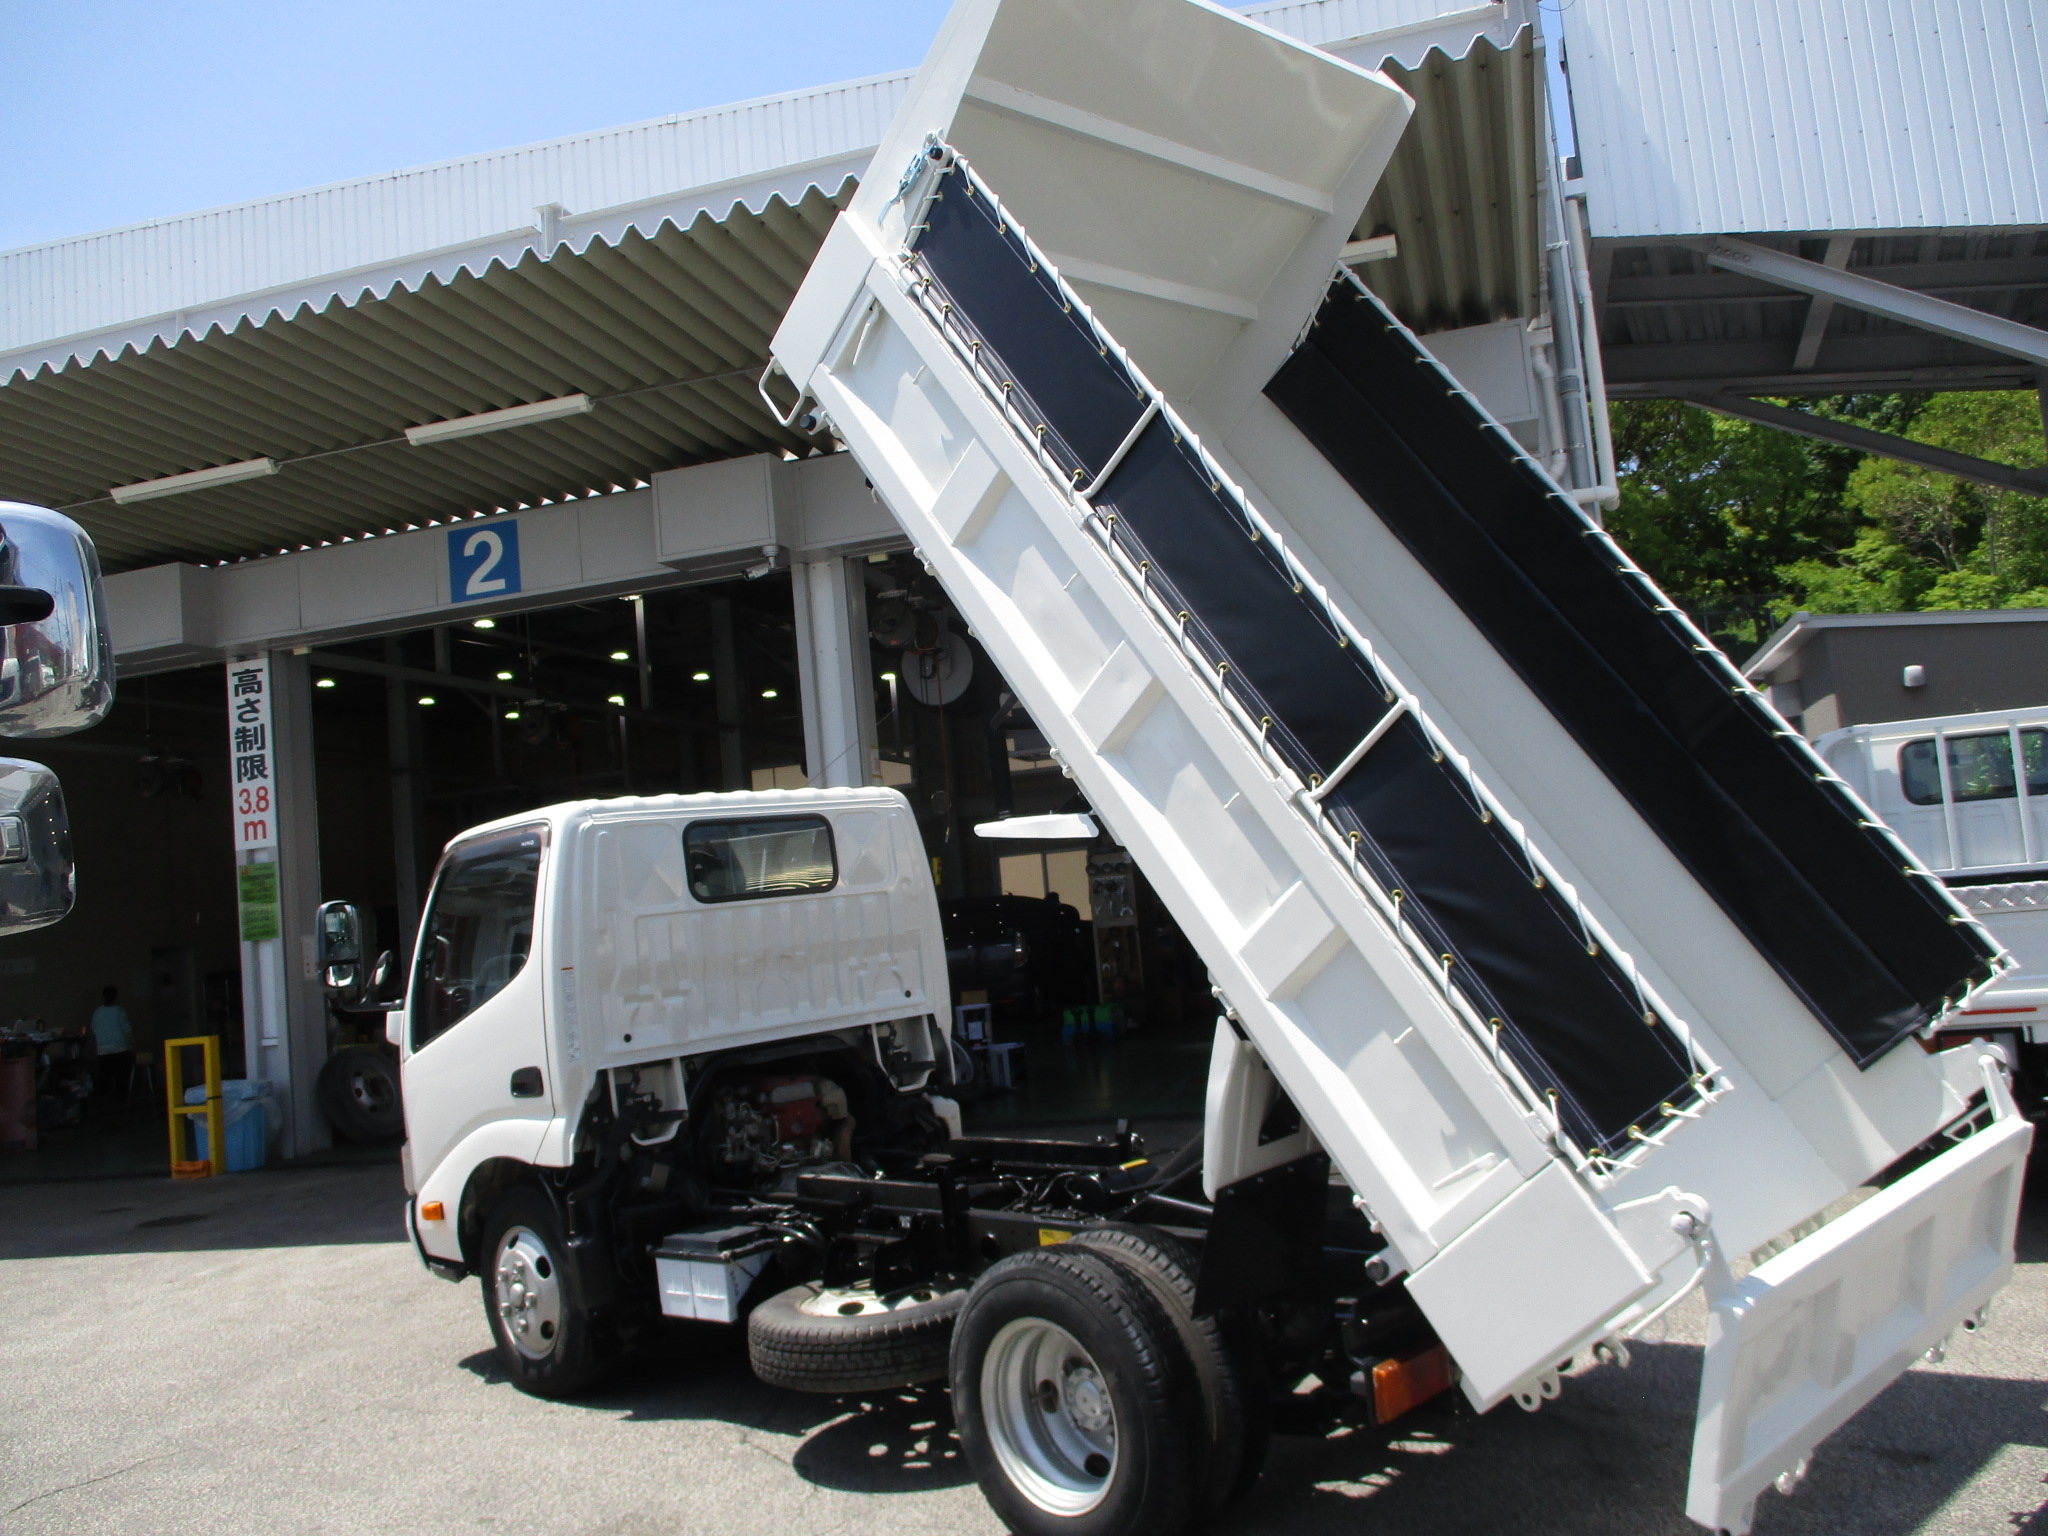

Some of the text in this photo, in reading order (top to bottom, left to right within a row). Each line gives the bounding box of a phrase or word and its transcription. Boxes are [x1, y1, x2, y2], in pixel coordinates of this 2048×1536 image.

[463, 530, 506, 595] 2
[232, 668, 269, 783] 高さ制限
[239, 786, 270, 815] 3.8
[244, 820, 267, 841] m
